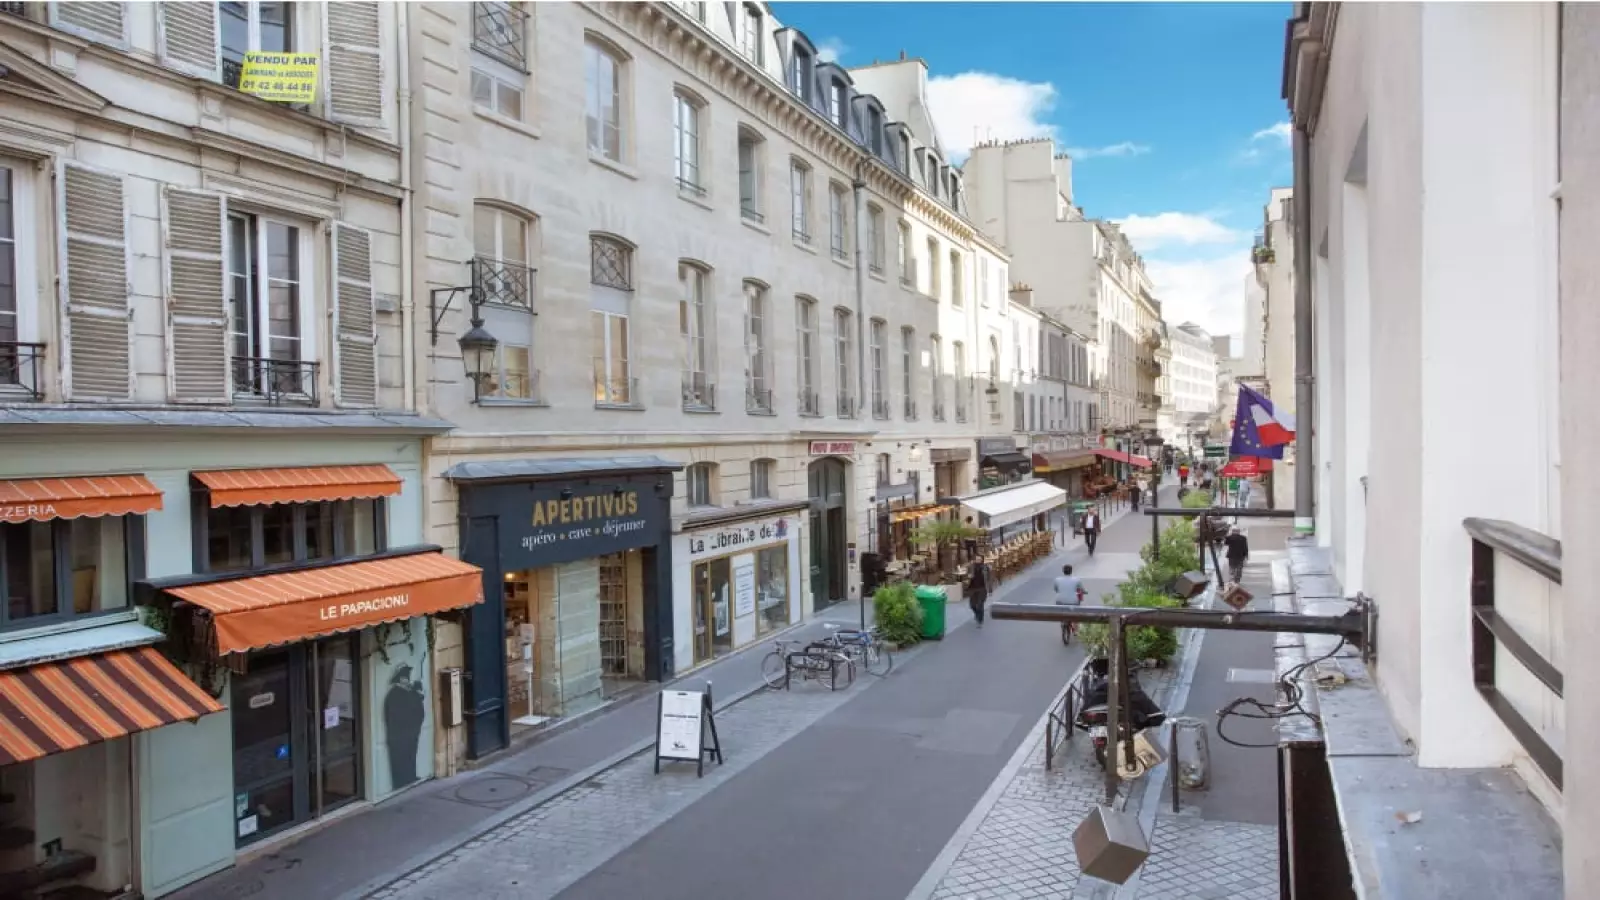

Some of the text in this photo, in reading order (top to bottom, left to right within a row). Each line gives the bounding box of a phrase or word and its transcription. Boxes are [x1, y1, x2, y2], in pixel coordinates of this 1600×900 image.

[247, 55, 316, 65] VENDU PAR
[532, 491, 638, 527] APERTIVUS
[522, 520, 646, 551] apéro cave déjeuner
[690, 538, 705, 554] La
[320, 606, 337, 620] LE
